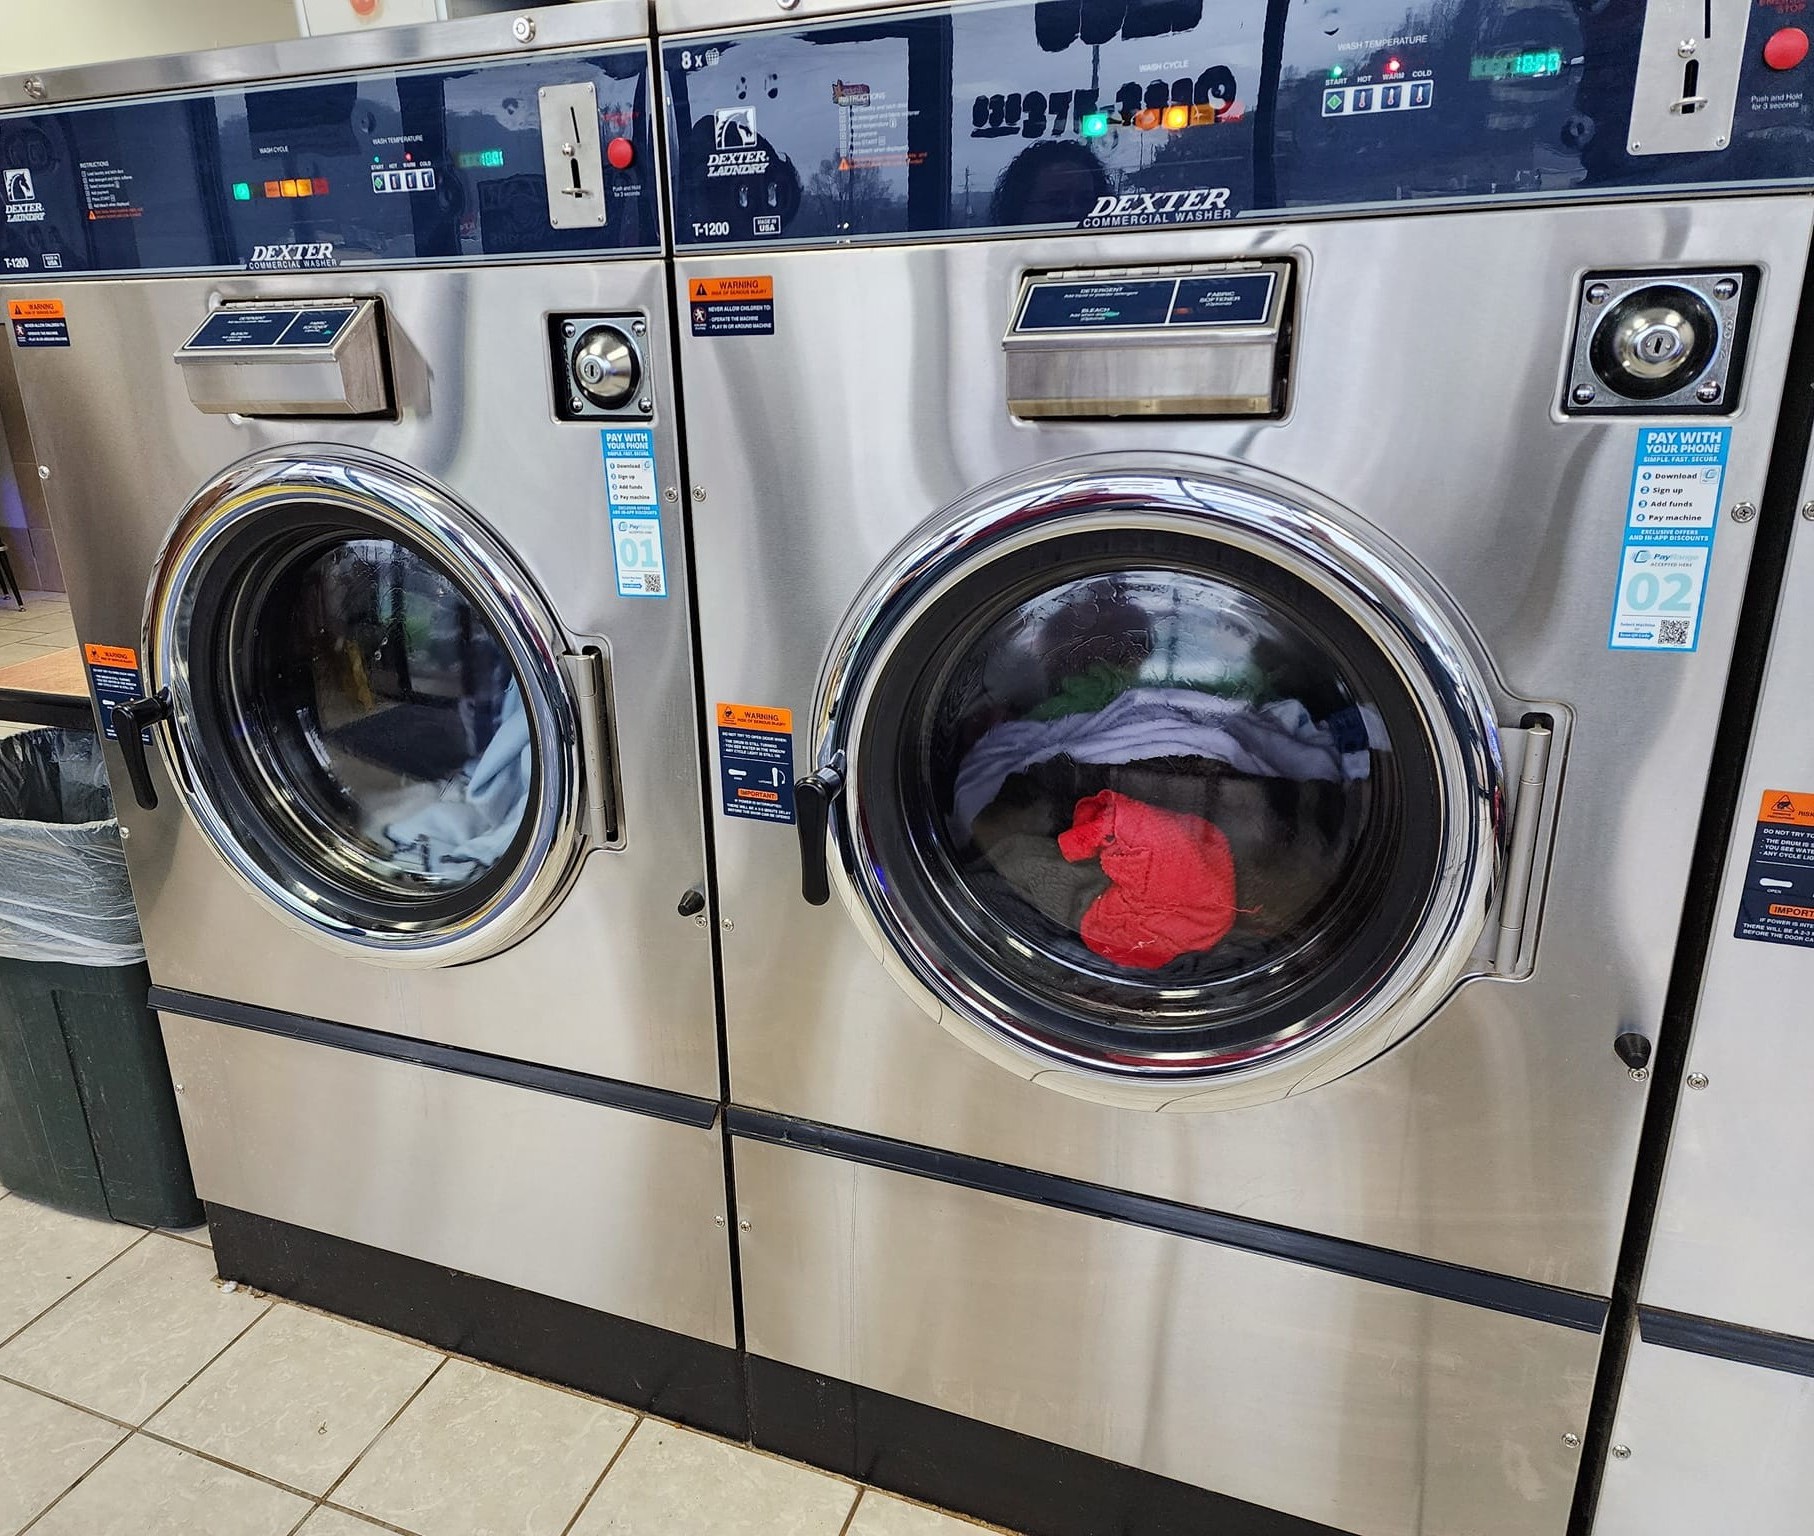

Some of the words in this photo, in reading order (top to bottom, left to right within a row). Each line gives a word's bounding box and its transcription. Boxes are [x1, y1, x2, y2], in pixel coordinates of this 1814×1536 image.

[1337, 41, 1363, 52] WASH
[1364, 35, 1428, 49] TEMPERATURE
[681, 50, 692, 70] 8
[694, 55, 703, 68] x
[1139, 63, 1162, 73] WASH
[1163, 60, 1189, 70] CYCLE
[1382, 72, 1405, 80] WARM
[1412, 70, 1432, 78] COLD
[1325, 78, 1348, 86] START
[1752, 103, 1761, 111] for
[1770, 101, 1799, 109] seconds
[388, 134, 423, 144] TEMPERATURE
[707, 150, 767, 166] DEXTER
[707, 162, 769, 177] LAUNDRY
[1088, 188, 1230, 217] DEXTER
[6, 203, 43, 214] DEXTER
[7, 212, 46, 222] LAUNDRY
[1083, 213, 1168, 228] COMMERCIAL
[1175, 209, 1232, 222] WASHER
[692, 222, 729, 236] T-1200
[759, 224, 775, 232] USA
[250, 243, 333, 261] DEXTER
[4, 257, 29, 268] T-1200
[249, 260, 300, 270] COMMERCIAL
[303, 259, 337, 267] WASHER
[720, 280, 758, 289] WARNING
[606, 433, 623, 442] PAY
[624, 433, 648, 442] WITH
[1647, 432, 1678, 444] PAY
[1680, 432, 1722, 444] WITH
[1646, 444, 1684, 454] YOUR
[1685, 444, 1720, 454] PHONE
[1652, 487, 1670, 495] Sign
[620, 538, 658, 568] 01
[1626, 572, 1693, 612] 02
[744, 712, 779, 721] WARNING
[1778, 852, 1801, 860] CYCLE
[1743, 922, 1765, 930] THERE
[1766, 918, 1791, 926] POWER
[1743, 929, 1769, 937] BEFORE
